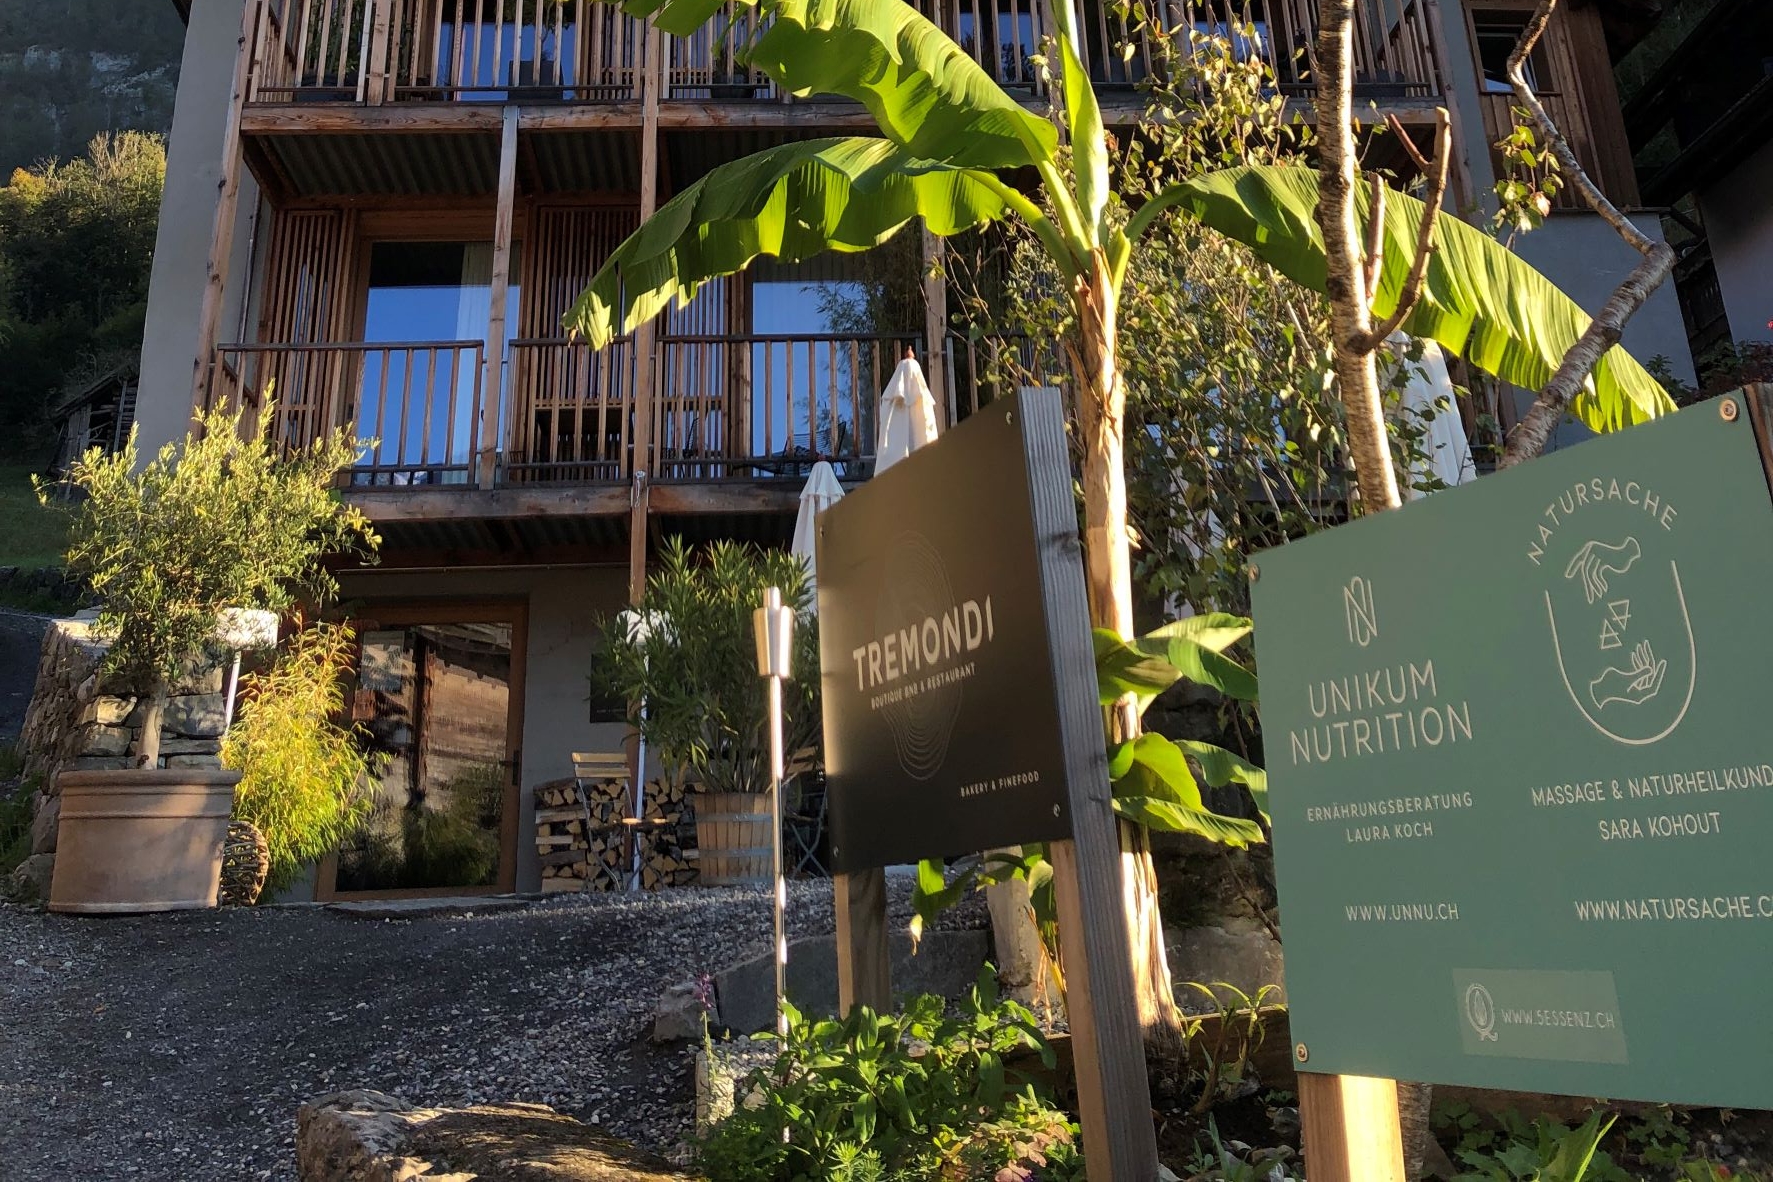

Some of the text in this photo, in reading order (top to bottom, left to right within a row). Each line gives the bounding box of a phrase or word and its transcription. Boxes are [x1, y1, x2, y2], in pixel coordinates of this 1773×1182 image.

[1527, 478, 1678, 566] NATURSACHE
[853, 594, 994, 691] TREMONDI
[871, 688, 902, 710] BOUTIQUE
[927, 662, 976, 690] RESTAURANT
[1309, 659, 1437, 717] UNIKUM
[1290, 702, 1473, 765] NUTRITION
[960, 781, 988, 798] BAKERY
[999, 770, 1040, 789] FINEFOOD
[1531, 781, 1605, 807] MASSAGE
[1611, 780, 1623, 799] &
[1307, 792, 1473, 822] ERNÄHRUNGSBERATUNG
[1346, 821, 1434, 843] LAURA KOCH
[1599, 812, 1721, 841] SARA KOHOUT
[1345, 903, 1460, 921] WWW.UNNU.CH
[1575, 895, 1773, 921] WWW.NATURSACHE.C
